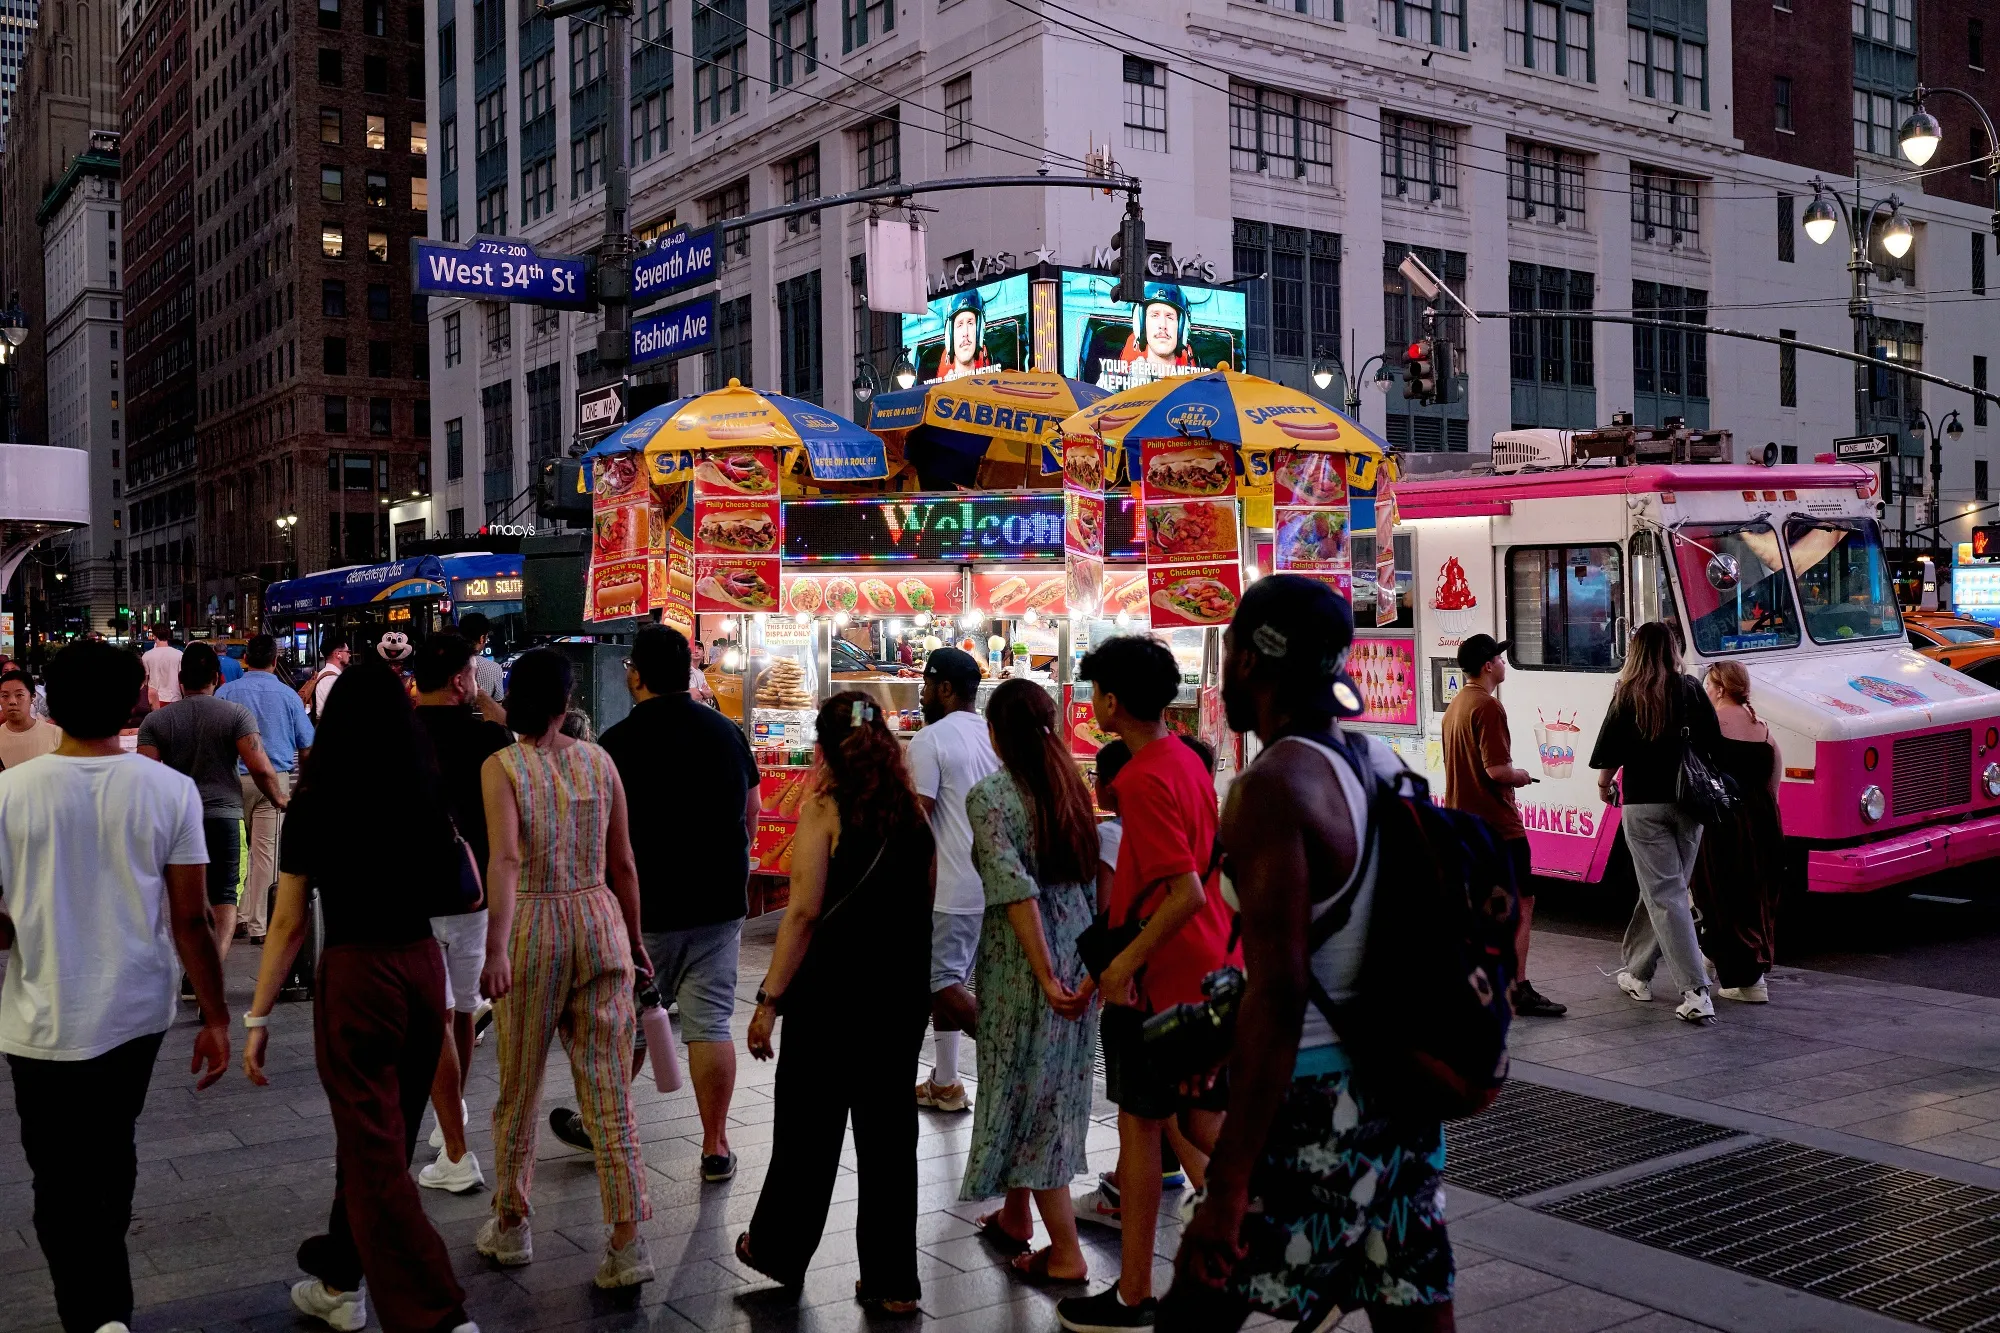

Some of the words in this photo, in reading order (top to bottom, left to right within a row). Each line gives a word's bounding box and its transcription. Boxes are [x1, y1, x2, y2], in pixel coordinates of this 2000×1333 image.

[479, 242, 499, 255] 272
[507, 245, 527, 257] 200
[634, 250, 684, 292] Seventh
[686, 246, 712, 274] Ave
[1093, 245, 1218, 284] MCY'S
[428, 254, 494, 287] West
[501, 262, 544, 289] 34th
[551, 267, 576, 294] St
[634, 321, 680, 355] Fashion
[682, 315, 707, 341] Ave
[1099, 357, 1129, 374] YOUR
[585, 403, 598, 420] ONE
[602, 397, 618, 415] WAY
[1244, 404, 1319, 426] SABRETT
[1147, 440, 1166, 450] Philly
[1167, 440, 1192, 448] Cheese
[1844, 445, 1859, 453] ONE
[1864, 441, 1881, 450] WAY
[834, 457, 843, 466] ON
[844, 457, 849, 466] A
[850, 457, 867, 466] ROLL
[705, 501, 724, 509] Philly
[489, 522, 536, 539] macy's
[388, 562, 405, 578] bus
[595, 567, 611, 580] BEST
[611, 563, 626, 573] NEW
[627, 562, 647, 571] YORK
[718, 559, 743, 567] Lamb
[745, 559, 767, 568] Gyro
[1292, 561, 1314, 569] Falafel
[1169, 568, 1201, 577] Chicken
[1202, 567, 1221, 577] Gyro
[466, 580, 488, 596] M20
[1151, 577, 1166, 585] NY
[603, 605, 619, 616] HOT
[619, 603, 636, 614] DO
[1448, 675, 1458, 690] A
[769, 770, 786, 780] Dog
[768, 824, 786, 834] Dog
